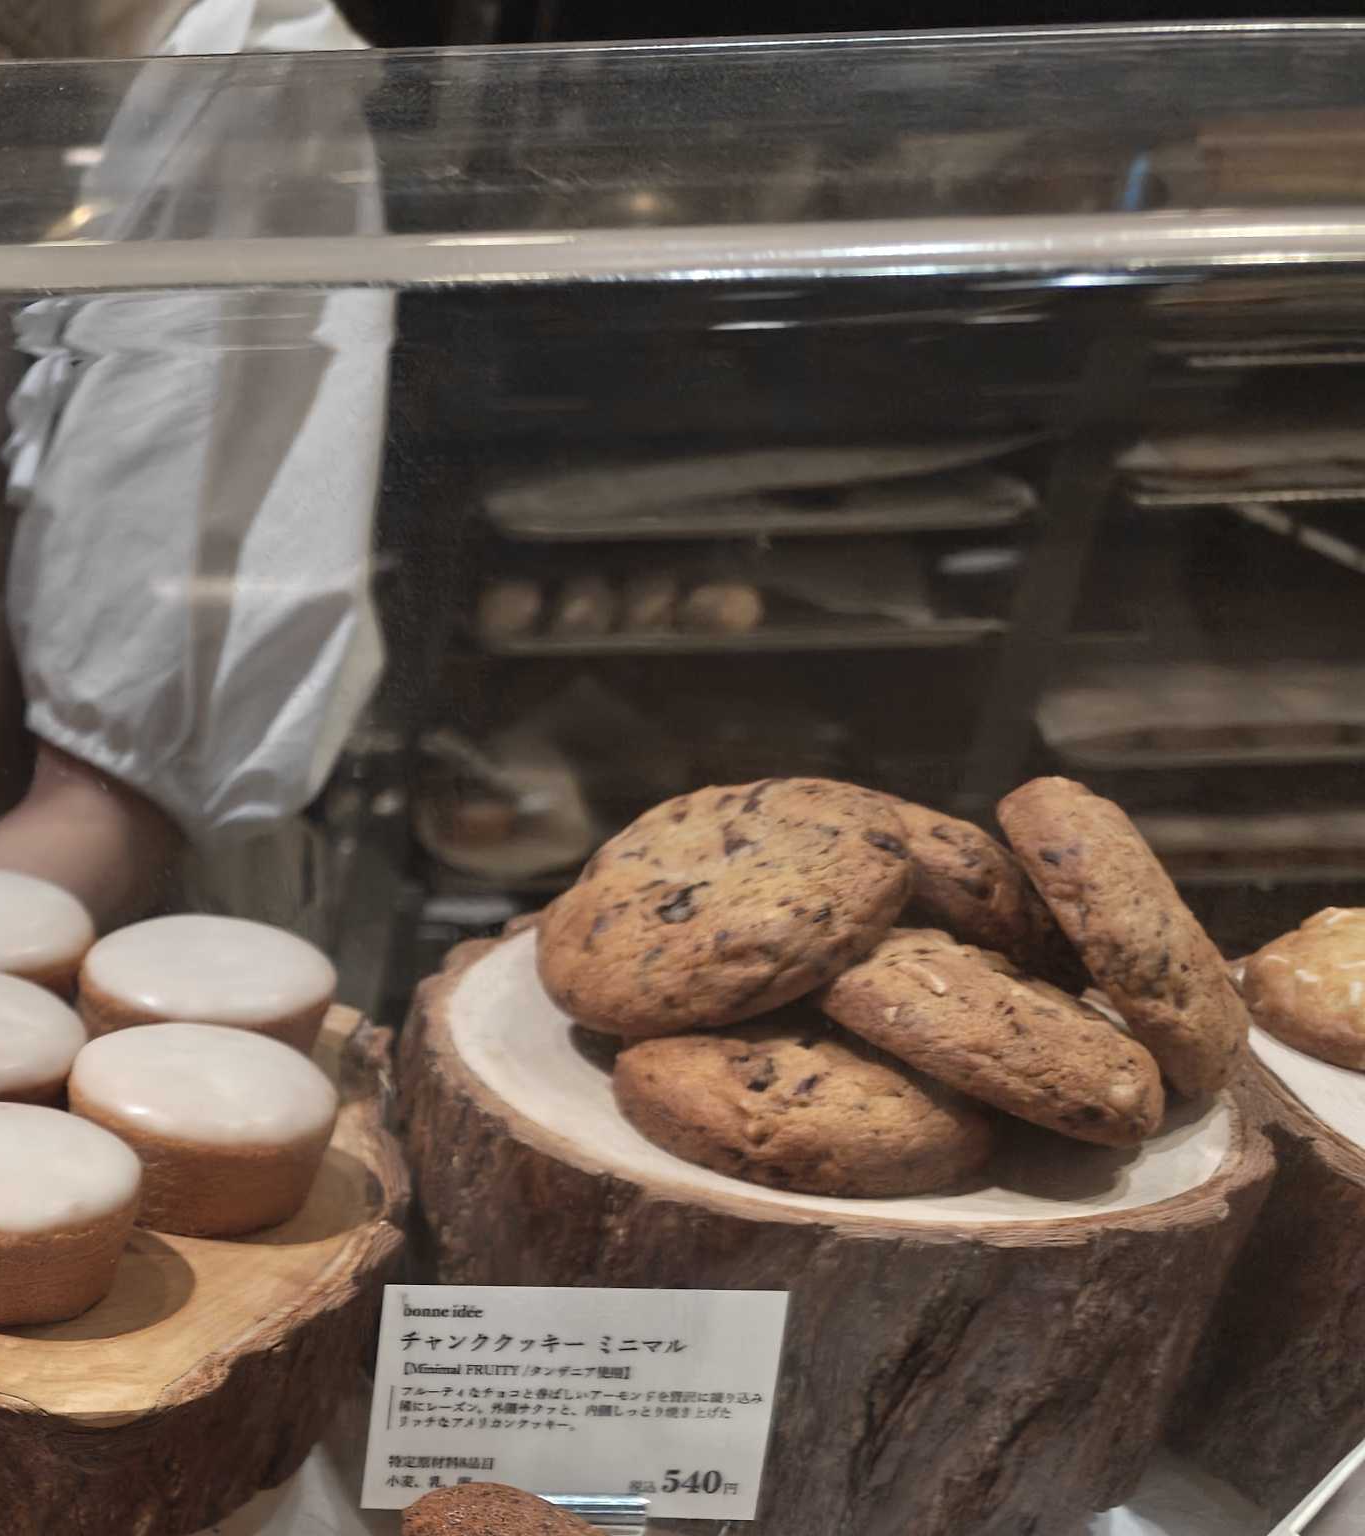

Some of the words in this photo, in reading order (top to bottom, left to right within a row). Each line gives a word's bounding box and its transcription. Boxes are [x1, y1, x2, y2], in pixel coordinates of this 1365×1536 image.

[400, 1332, 585, 1352] チャンククッキー
[600, 1336, 687, 1354] ミニマル
